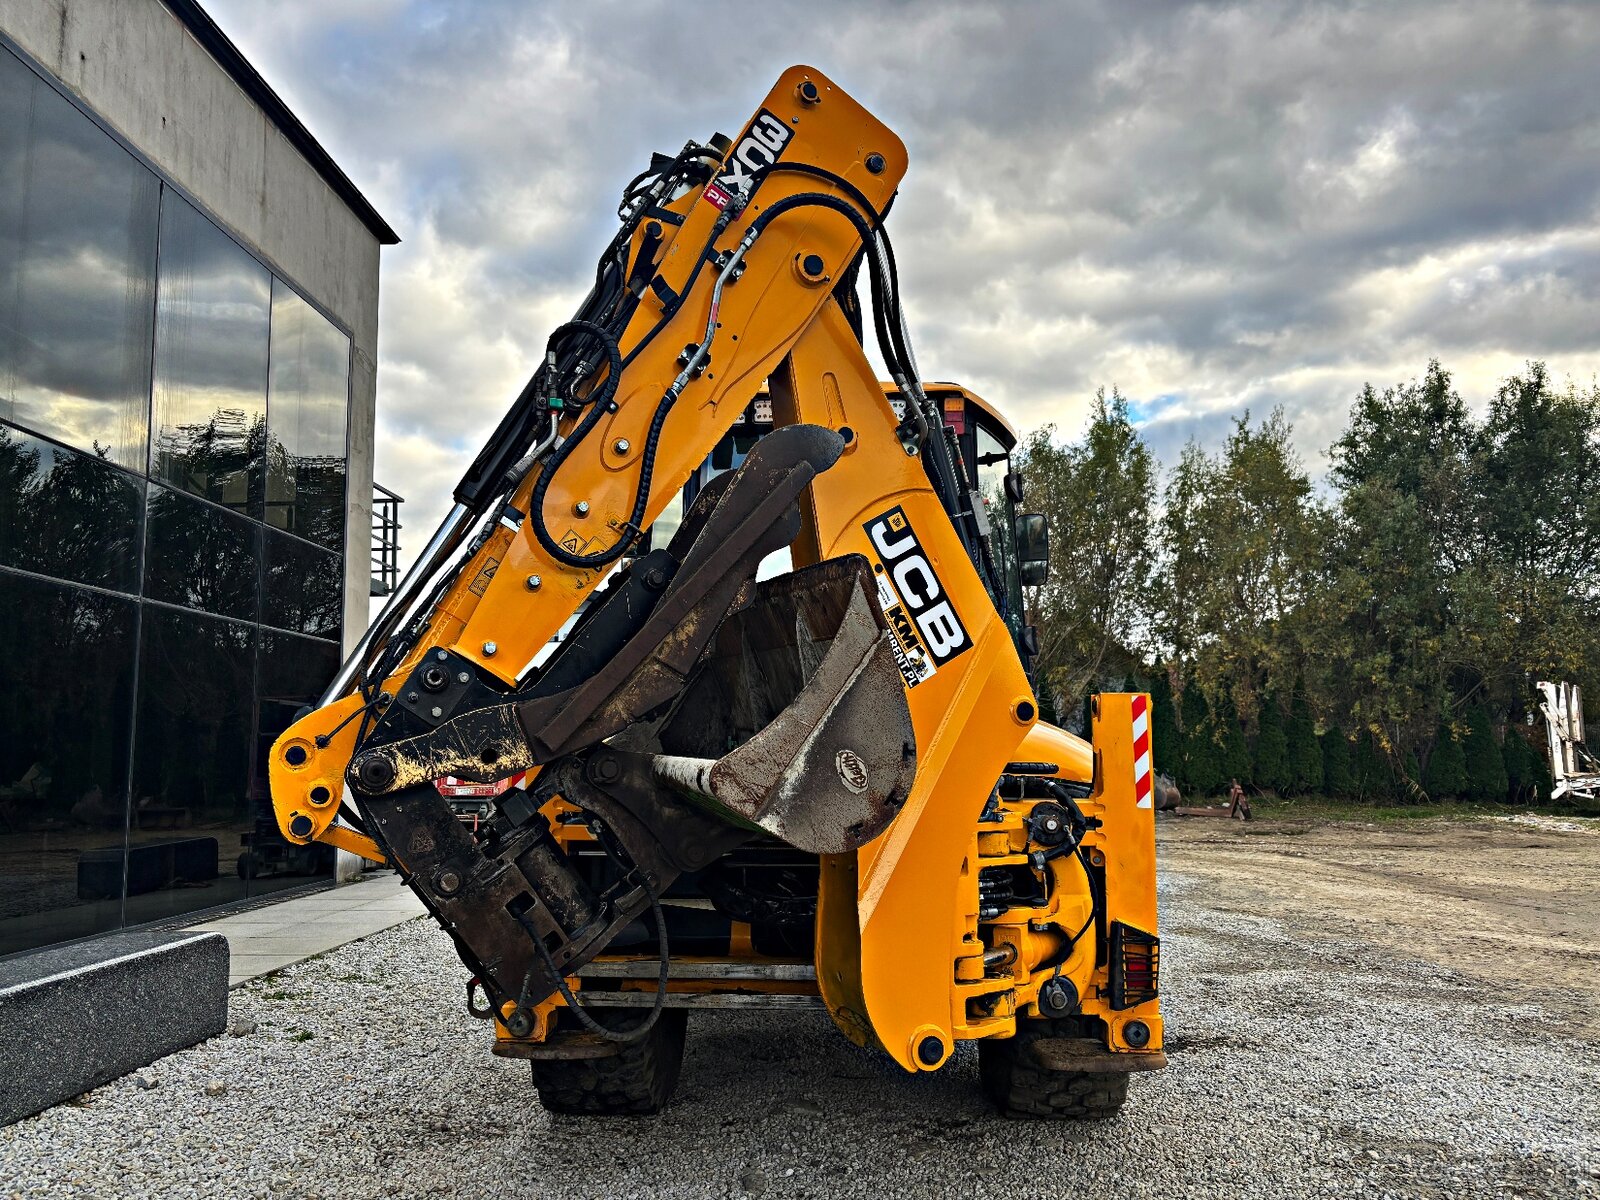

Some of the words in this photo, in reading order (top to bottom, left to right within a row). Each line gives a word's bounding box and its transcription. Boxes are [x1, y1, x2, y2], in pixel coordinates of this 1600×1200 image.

[718, 114, 789, 200] 3CX
[871, 520, 965, 658] JCB
[886, 628, 919, 688] MRENT.PL
[888, 607, 920, 651] KM
